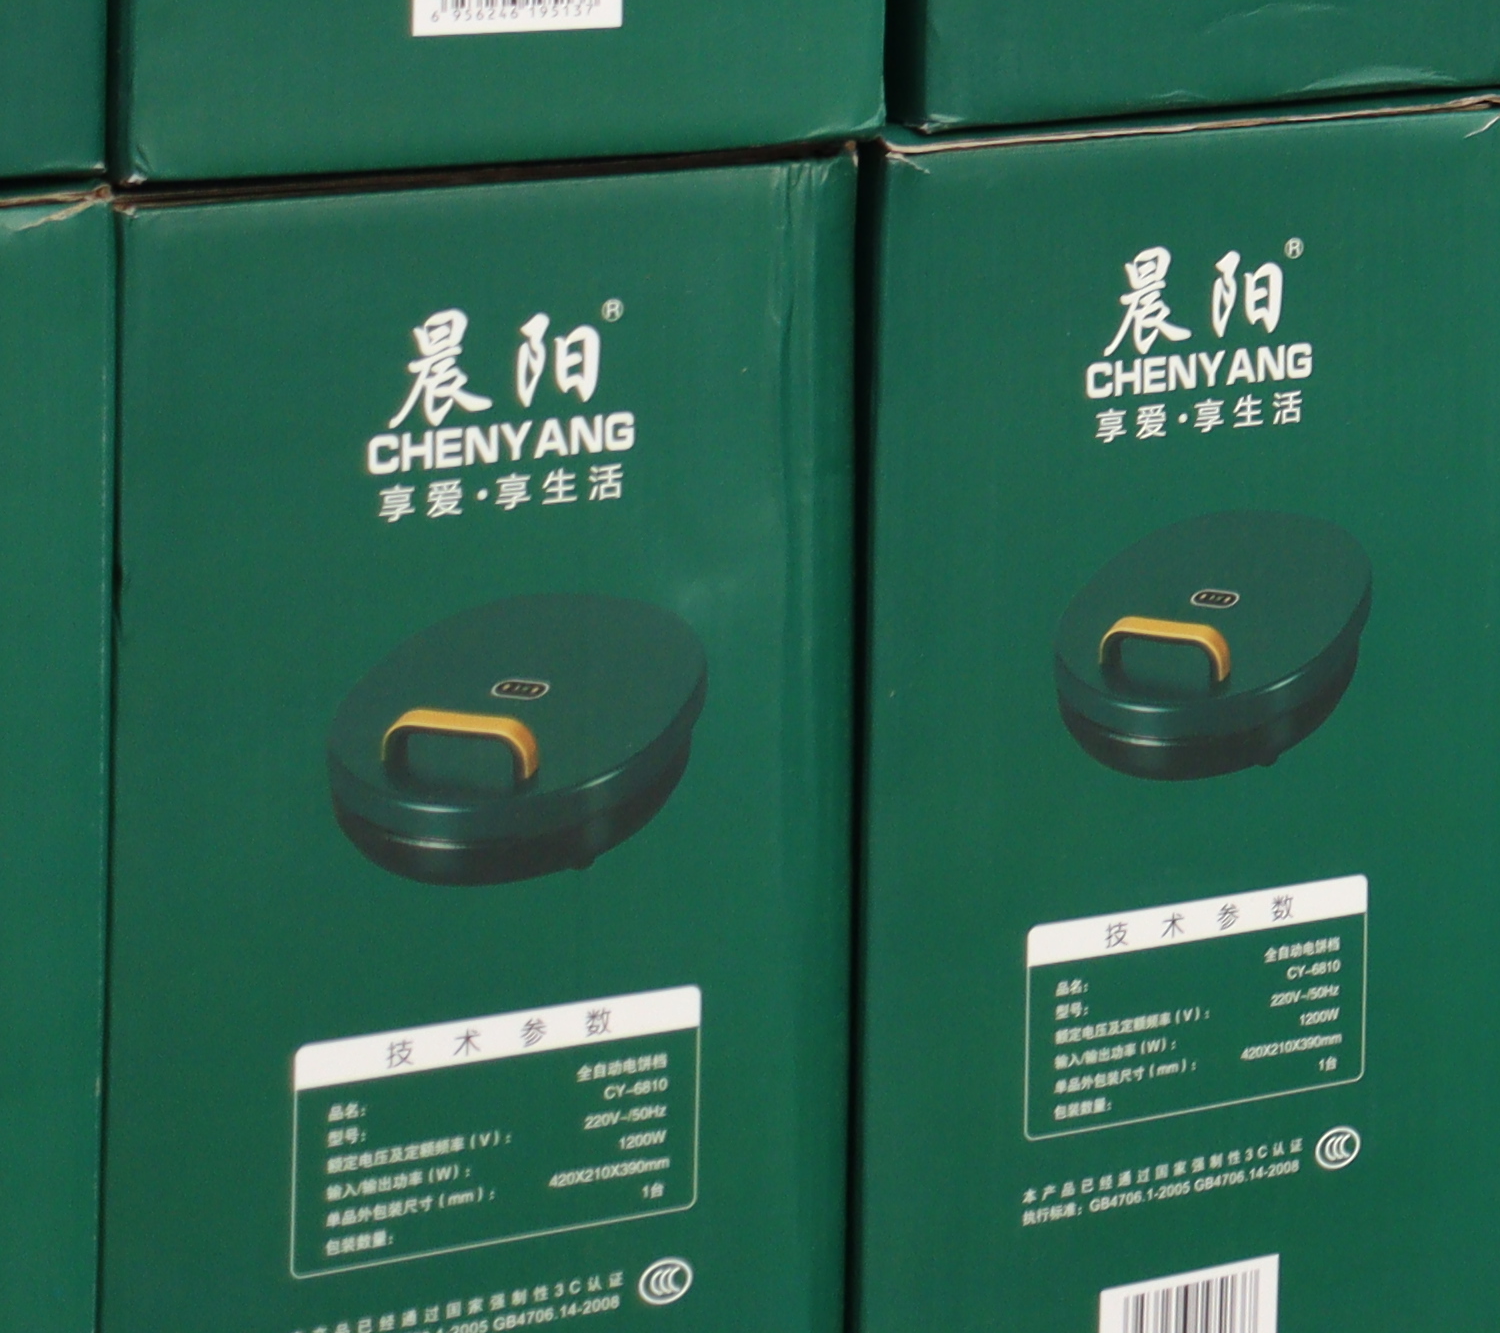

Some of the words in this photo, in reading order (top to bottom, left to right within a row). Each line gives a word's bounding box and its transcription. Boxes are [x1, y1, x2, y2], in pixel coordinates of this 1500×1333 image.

[1104, 247, 1283, 356] 晨阳
[388, 308, 601, 429] 晨阳
[1086, 343, 1313, 399] CHENYANG
[367, 411, 636, 475] CHENYANG
[1095, 390, 1303, 444] 享爱·享生活
[378, 463, 624, 523] 享爱·享生活
[1104, 895, 1294, 948] 技术参数
[386, 1007, 612, 1070] 技术参数
[619, 1130, 667, 1150] 1200W
